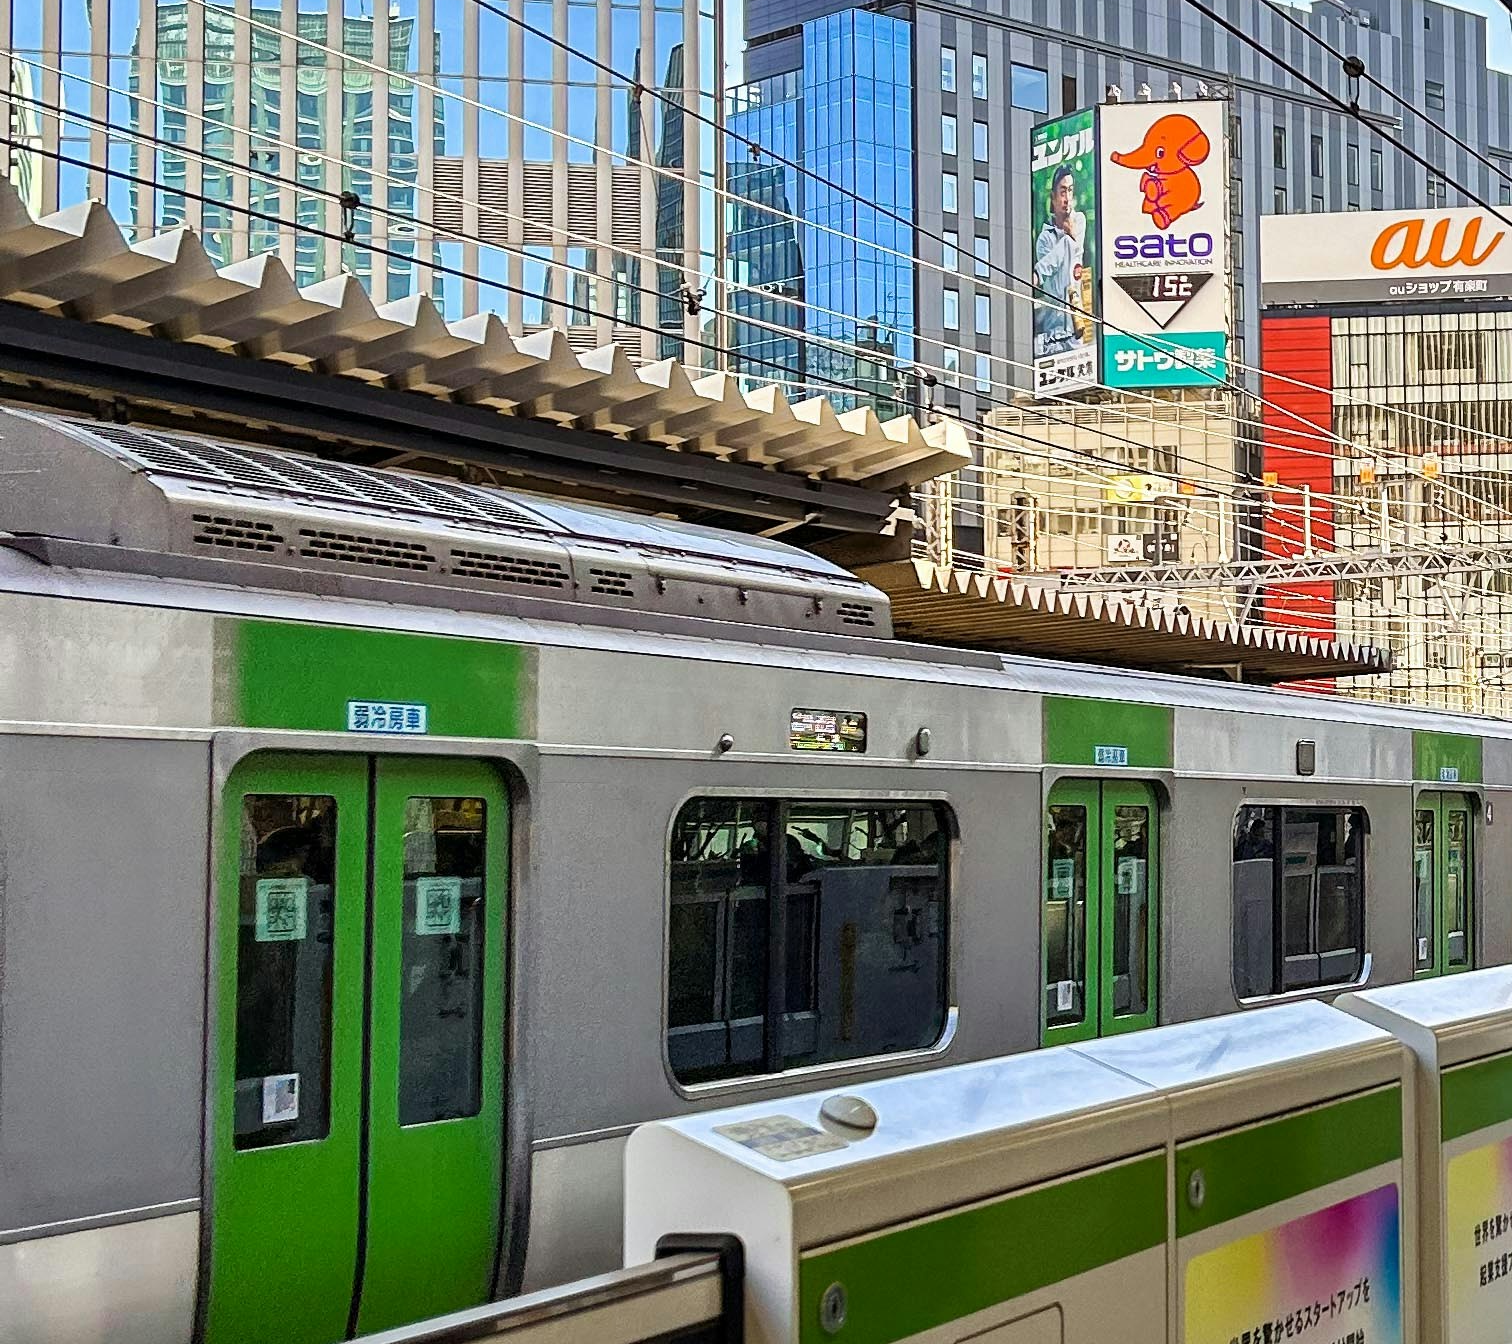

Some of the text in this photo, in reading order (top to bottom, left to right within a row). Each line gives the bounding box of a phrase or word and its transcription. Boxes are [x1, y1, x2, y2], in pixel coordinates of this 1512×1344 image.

[1114, 233, 1213, 259] sato
[1371, 216, 1505, 270] au
[1165, 258, 1213, 267] INNOVATION
[1389, 280, 1488, 295] auショップ有楽町
[1114, 348, 1217, 372] サトウ製薬
[354, 705, 421, 730] 弱冷房車
